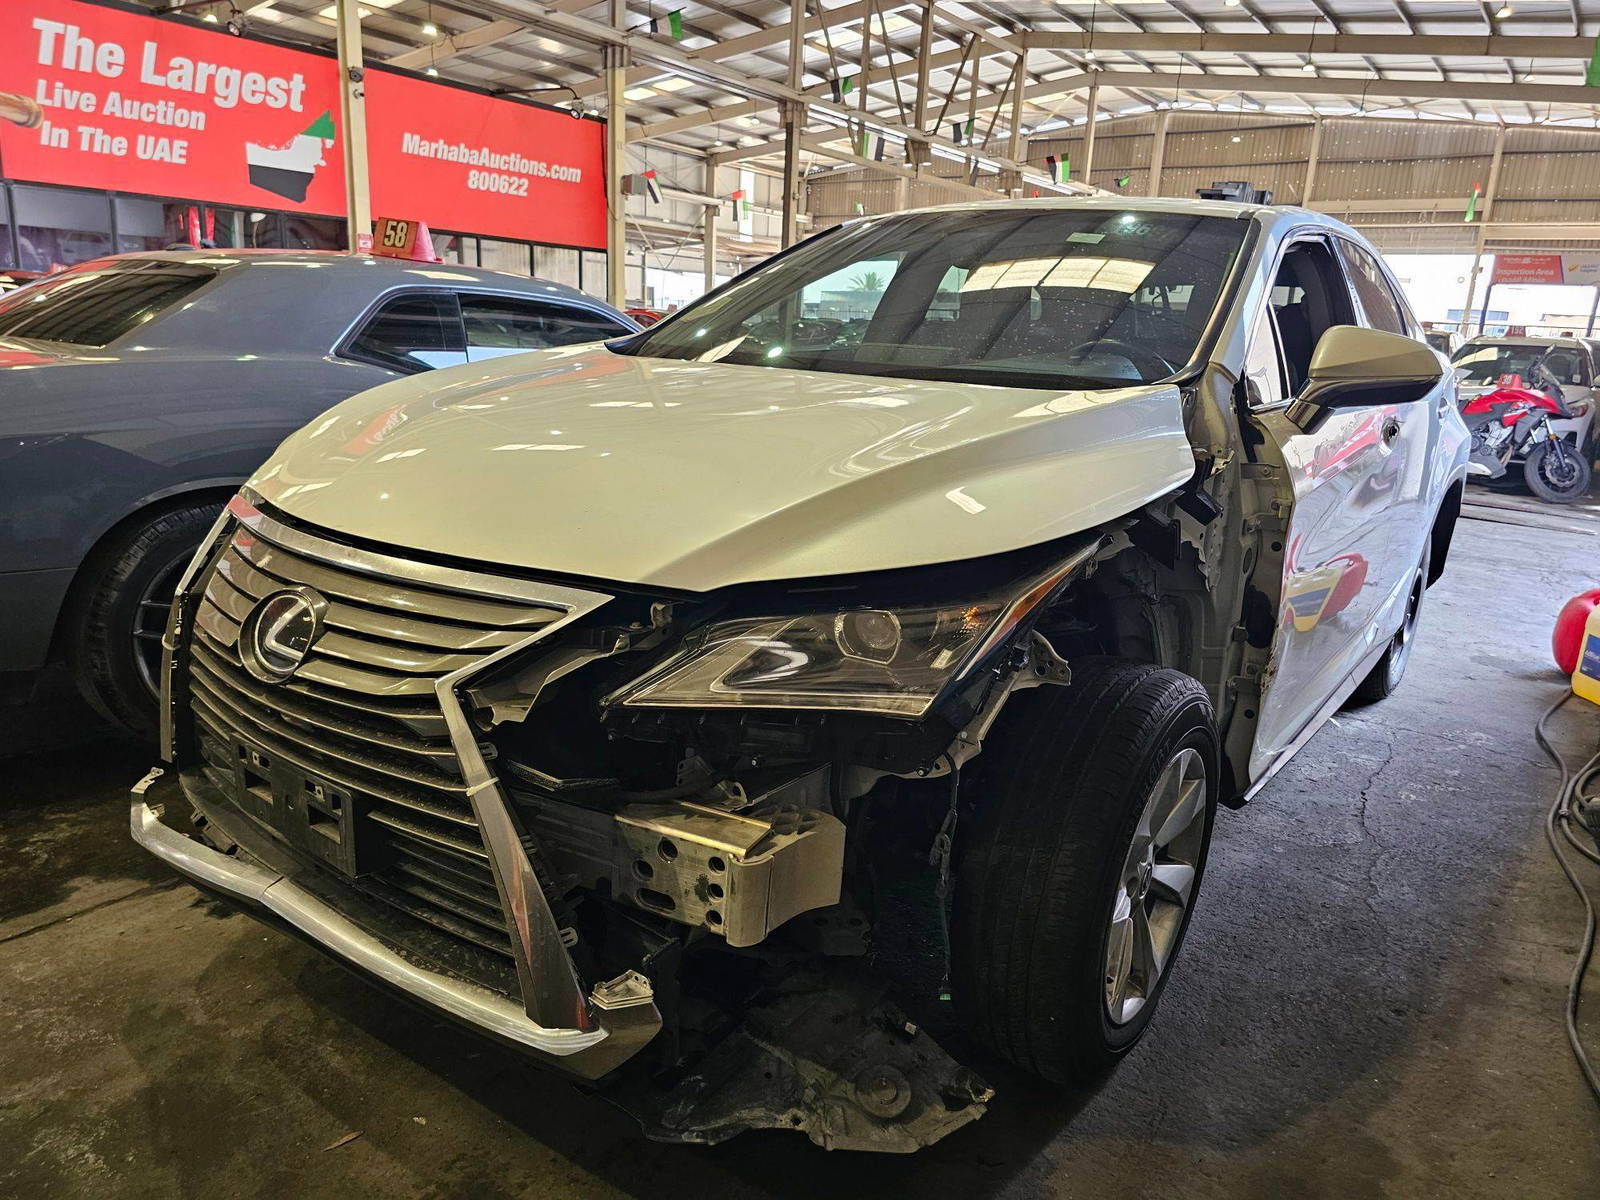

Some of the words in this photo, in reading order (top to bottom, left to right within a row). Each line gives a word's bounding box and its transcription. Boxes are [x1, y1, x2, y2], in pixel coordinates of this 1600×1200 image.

[32, 18, 125, 78] The
[140, 41, 306, 112] Largest
[36, 79, 97, 113] Live
[102, 92, 206, 130] Auction
[40, 121, 69, 149] In
[77, 126, 128, 156] The
[136, 135, 188, 164] UAE
[401, 132, 582, 184] MarhabaAuctions.com
[467, 170, 529, 197] 800622
[383, 220, 408, 248] 58
